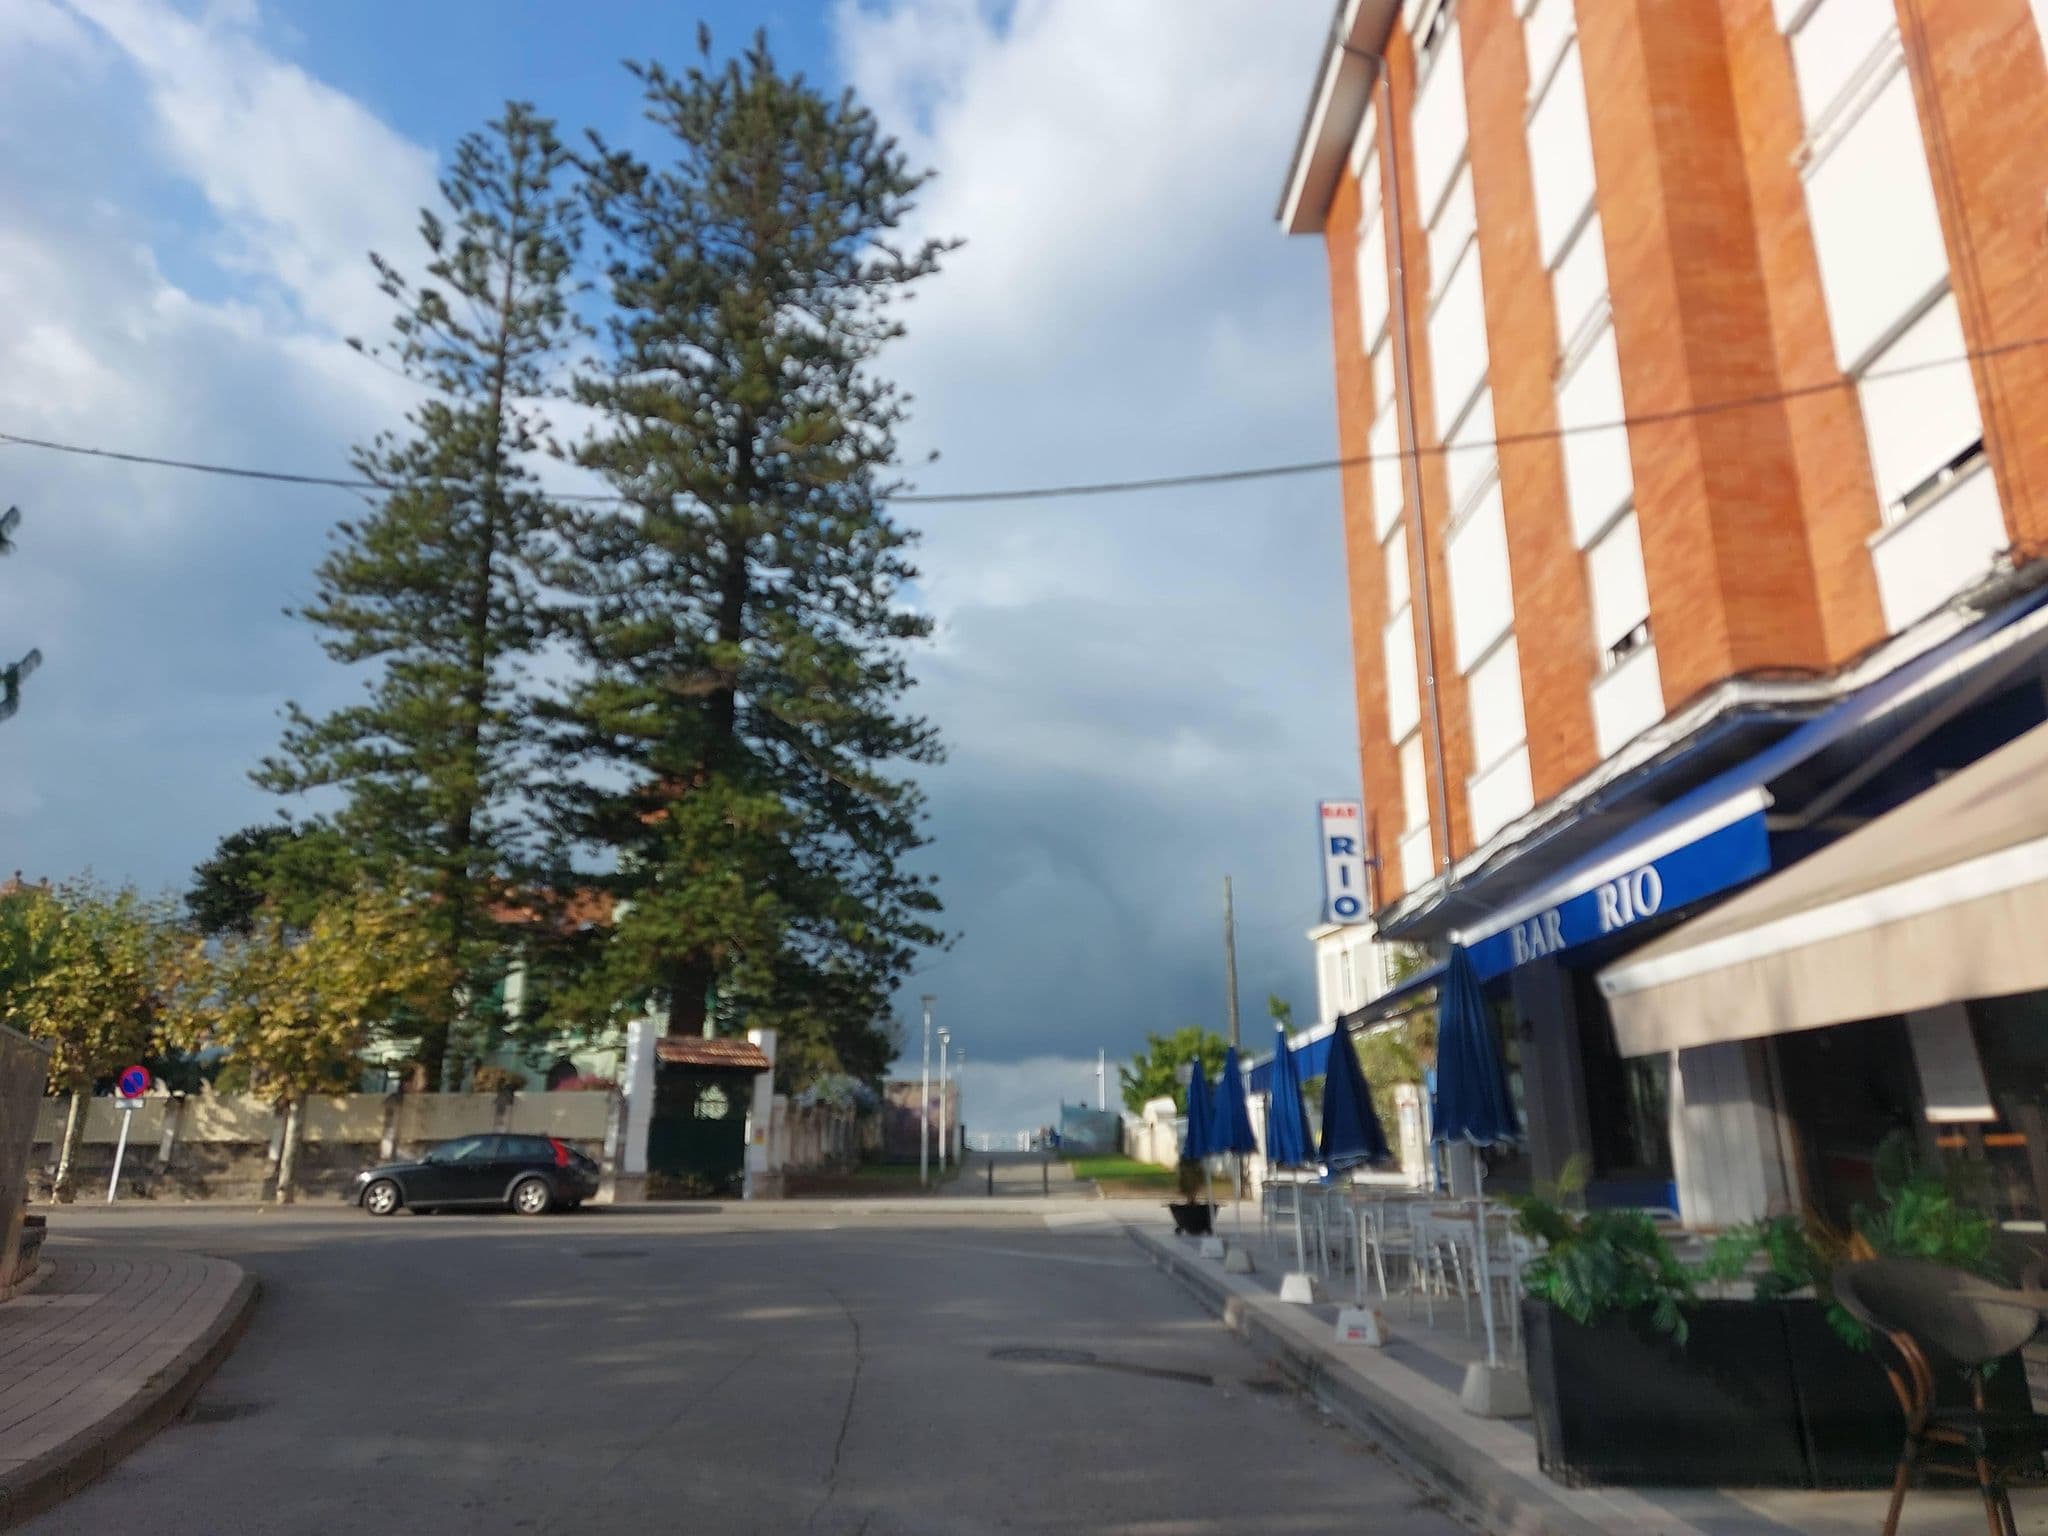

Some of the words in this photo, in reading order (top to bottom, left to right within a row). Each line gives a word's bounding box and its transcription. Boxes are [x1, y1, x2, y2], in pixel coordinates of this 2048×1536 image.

[1322, 807, 1357, 817] BAR
[1330, 836, 1361, 916] RIO
[1510, 907, 1567, 966] BAR
[1597, 864, 1663, 933] RIO
